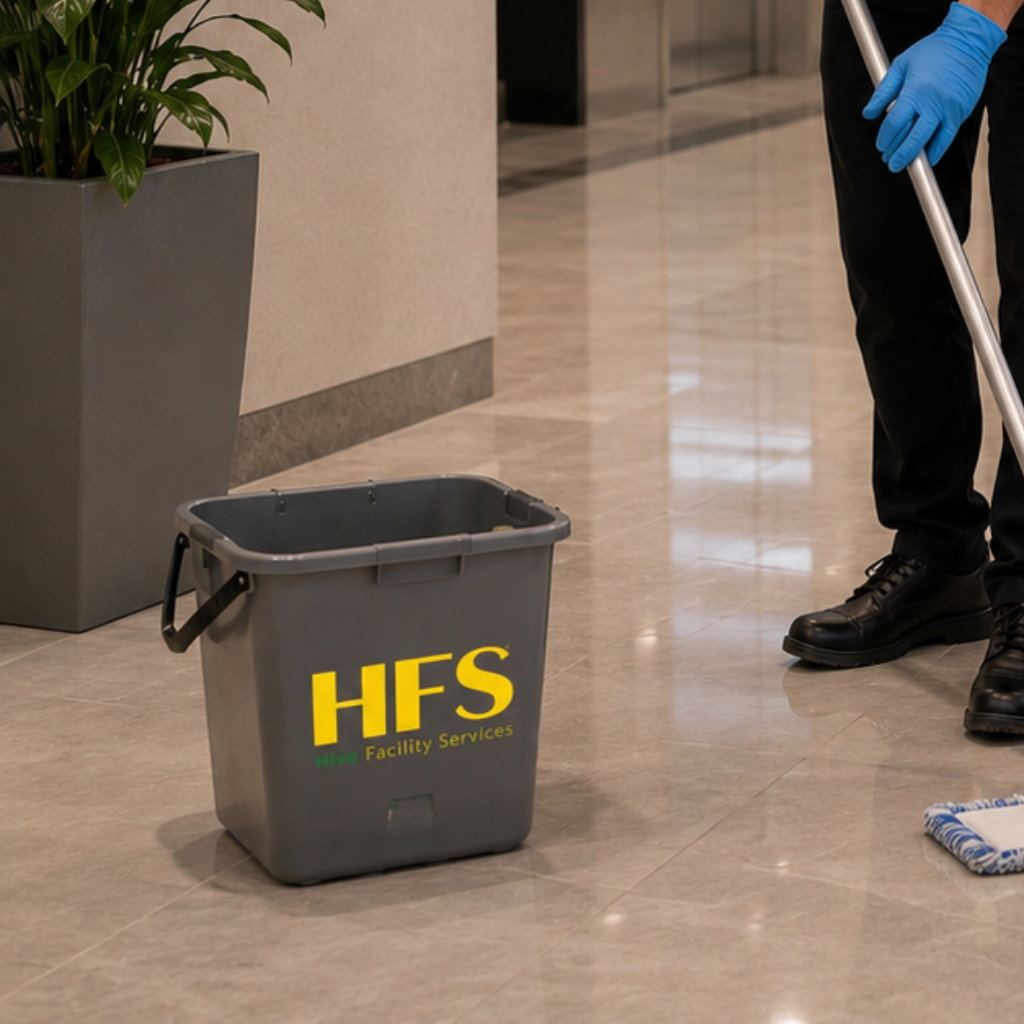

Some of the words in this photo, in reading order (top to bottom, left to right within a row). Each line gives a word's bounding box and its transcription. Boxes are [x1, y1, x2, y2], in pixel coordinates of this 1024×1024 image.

[311, 645, 514, 747] HFS
[314, 752, 358, 769] Hive
[364, 739, 433, 762] Facility
[438, 724, 514, 750] Services
